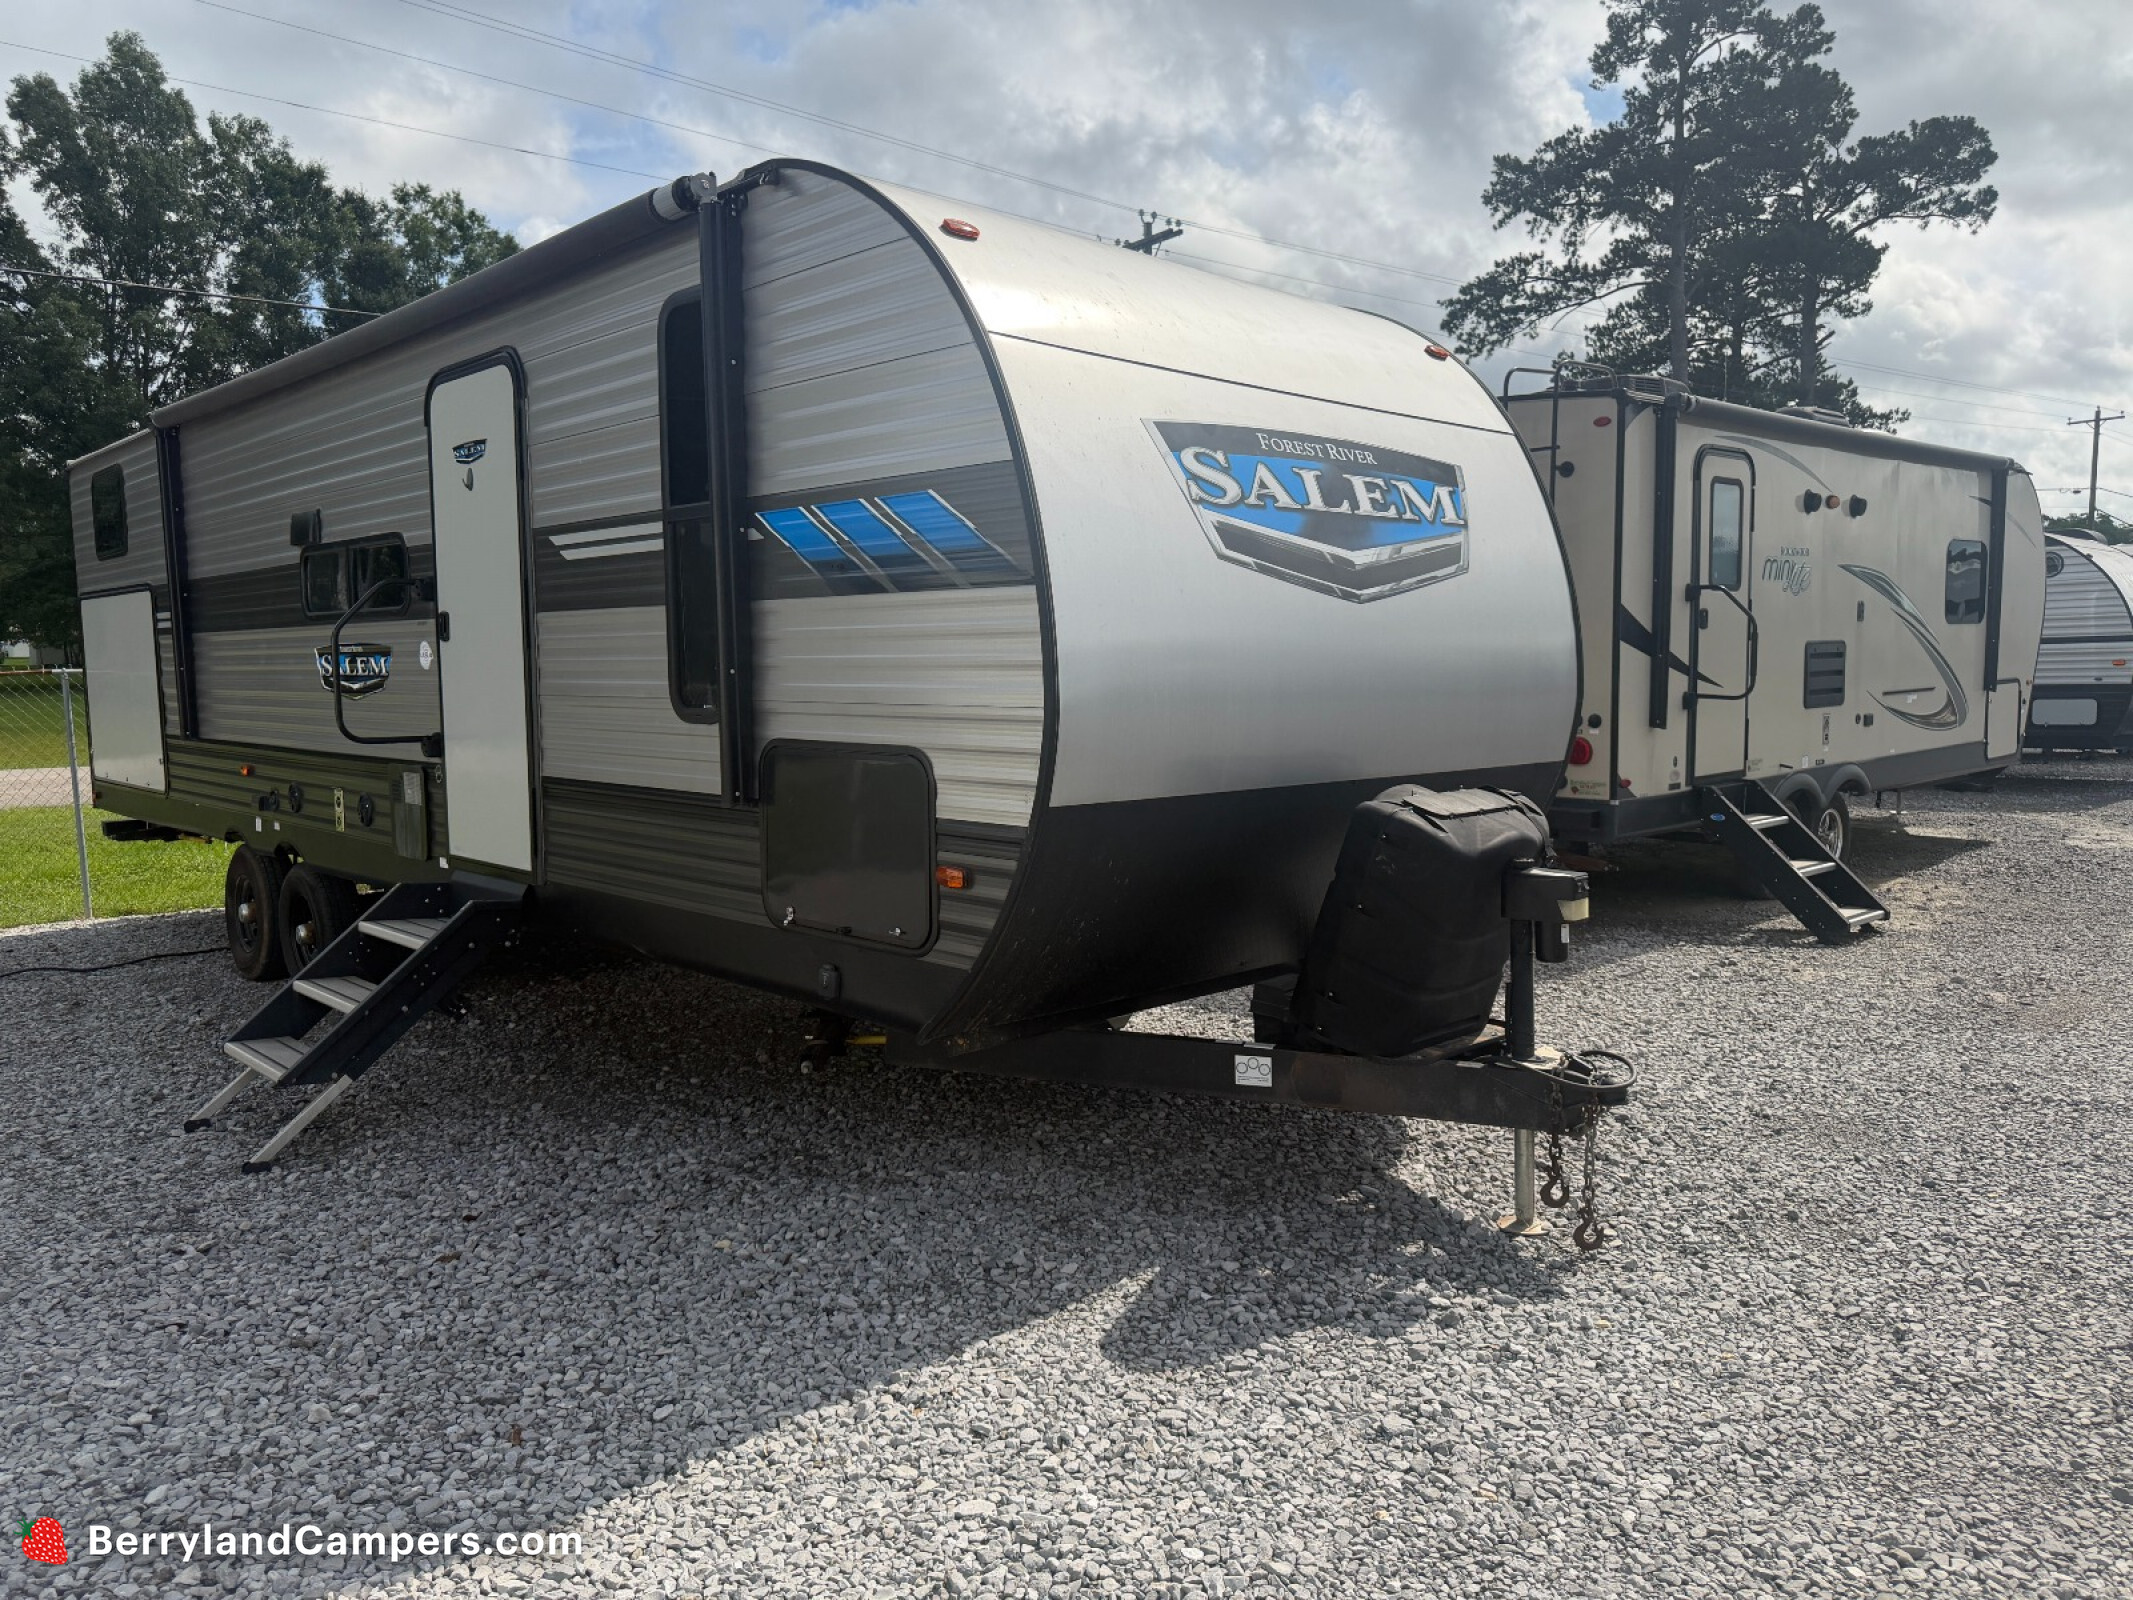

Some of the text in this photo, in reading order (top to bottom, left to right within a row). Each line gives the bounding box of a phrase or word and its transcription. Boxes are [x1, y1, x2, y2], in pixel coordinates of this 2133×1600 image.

[1256, 432, 1378, 465] FOREST RIVER
[1179, 446, 1466, 525] SALEM
[321, 654, 389, 677] SLEM
